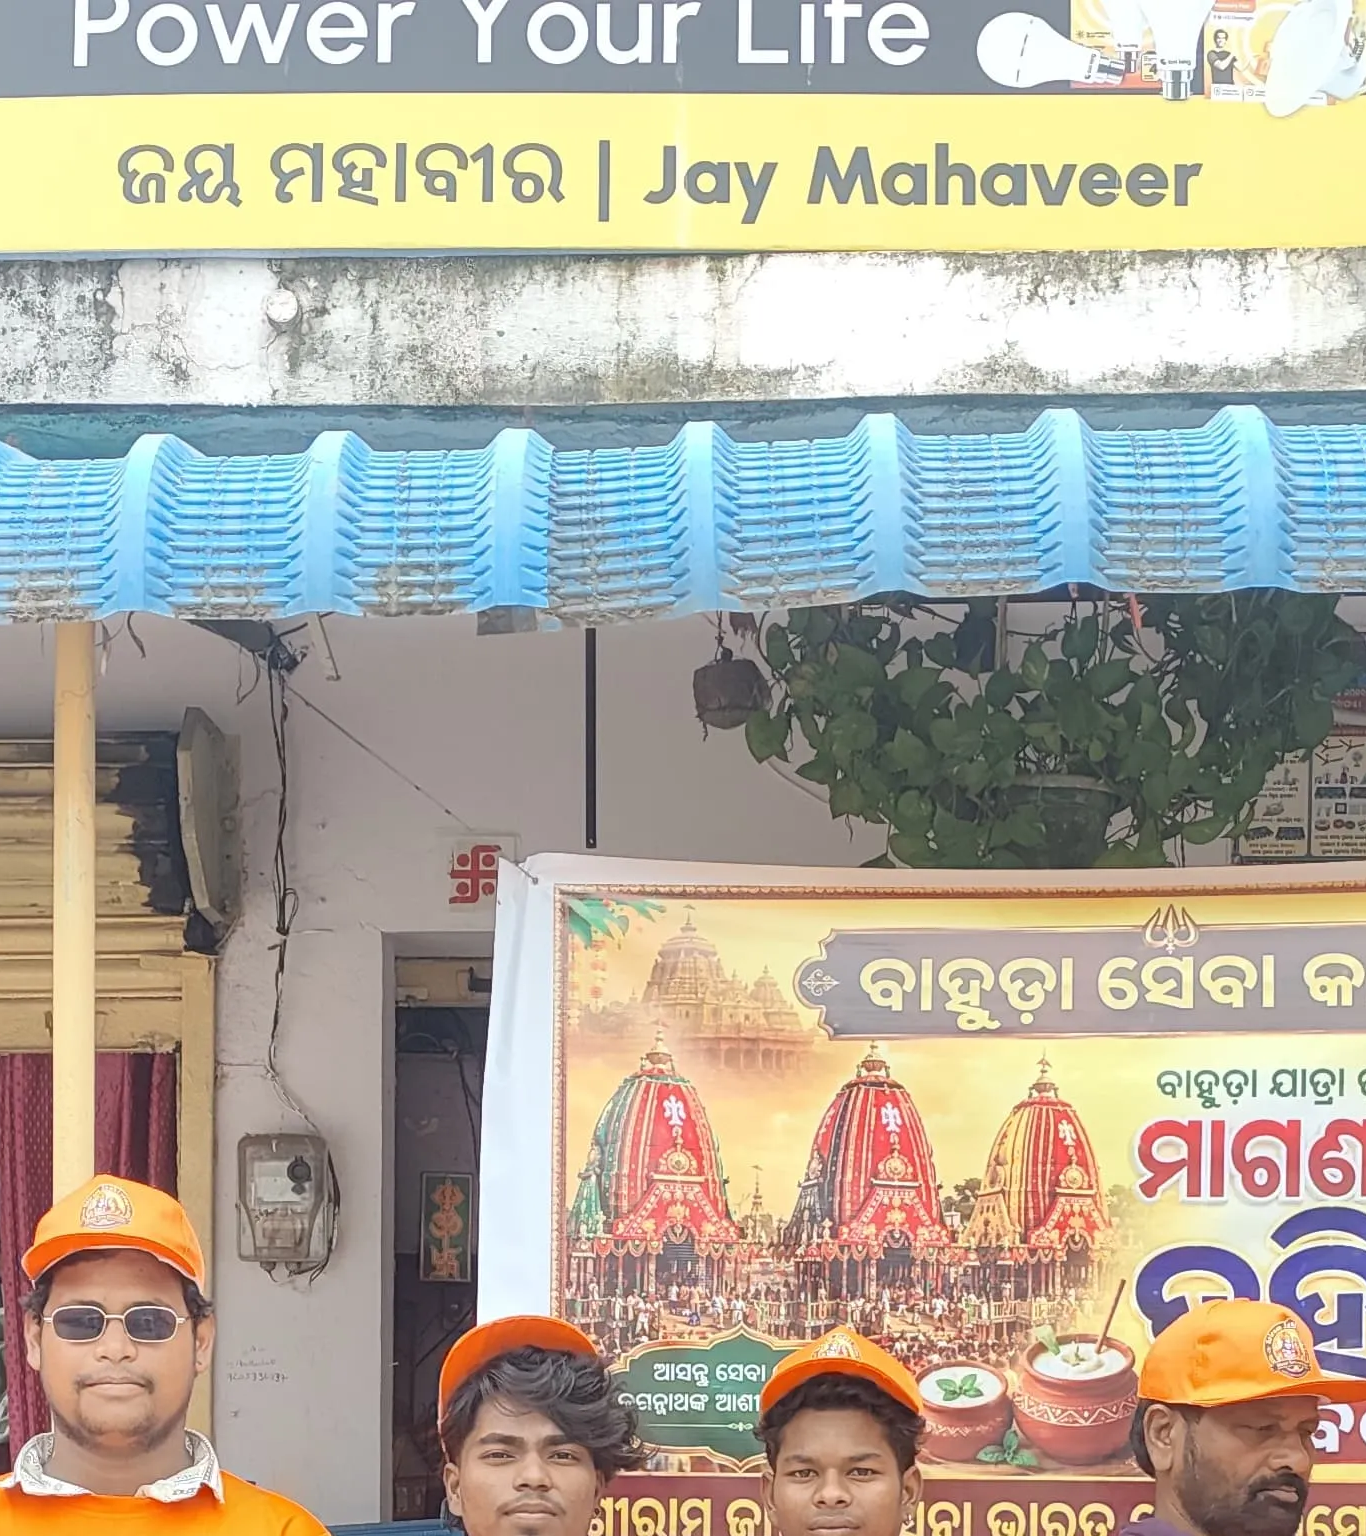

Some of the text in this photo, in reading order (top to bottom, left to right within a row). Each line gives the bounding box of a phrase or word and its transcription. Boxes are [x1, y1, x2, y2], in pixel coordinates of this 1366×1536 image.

[72, 0, 930, 67] Power Your Life
[117, 142, 243, 207] ଜୟ
[270, 142, 565, 206] ମହାବୀର
[643, 145, 779, 225] Jay
[807, 142, 1202, 208] Mahaveer
[860, 955, 1073, 1032] ବାହୁଡ଼ା
[1097, 953, 1275, 1012] ସେବା
[1156, 1069, 1258, 1109] ବାହୁଡ଼ା
[1269, 1068, 1345, 1106] ଯାତ୍ରା
[715, 1363, 766, 1382] ସେବା
